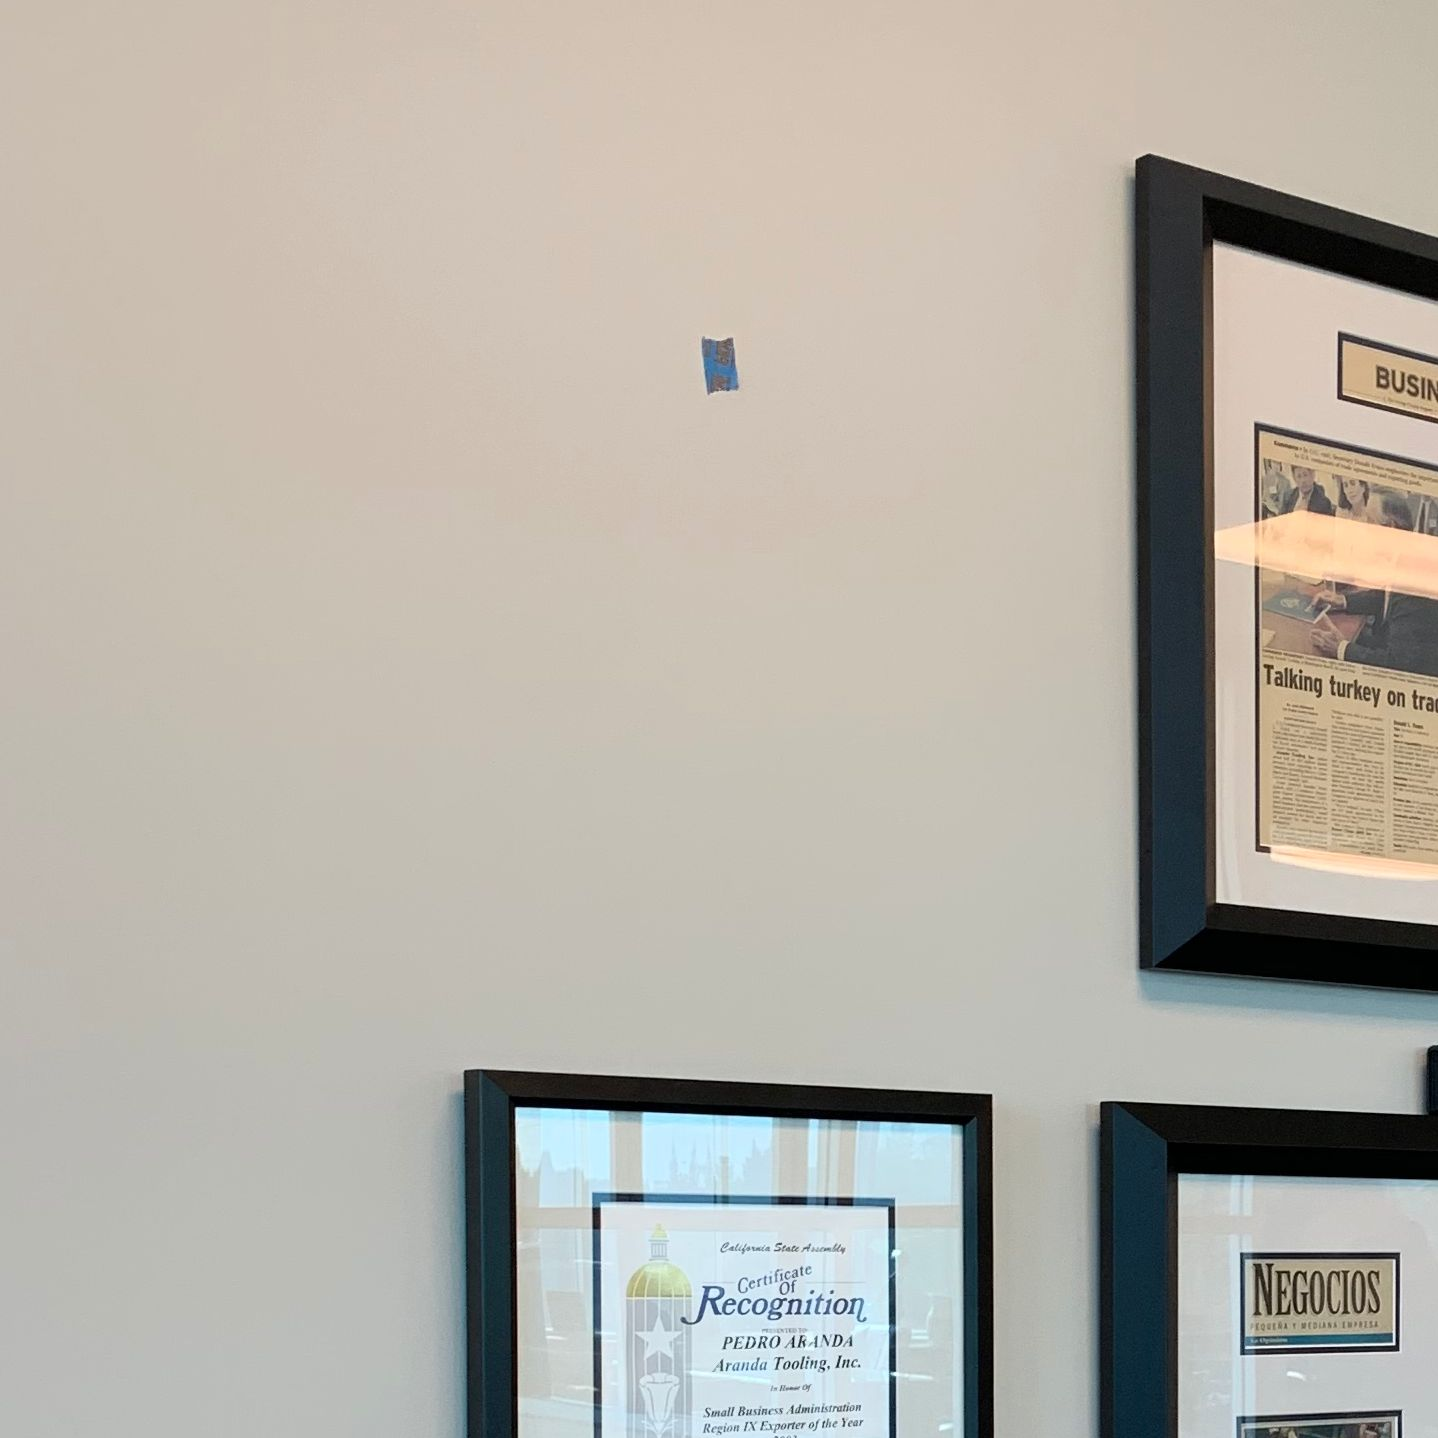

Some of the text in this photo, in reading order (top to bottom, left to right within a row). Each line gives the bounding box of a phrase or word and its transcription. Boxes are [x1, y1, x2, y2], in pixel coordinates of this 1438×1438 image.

[1263, 664, 1323, 698] Talking
[1329, 675, 1381, 707] turkey
[1387, 686, 1406, 707] on
[720, 1241, 846, 1255] California State Assembly
[737, 1264, 813, 1294] Certificate
[779, 1279, 796, 1296] Of
[1252, 1262, 1382, 1318] NEGOCIOS
[680, 1285, 867, 1326] Recognition
[1300, 1320, 1338, 1329] MEDIANA
[1342, 1320, 1379, 1329] EMPRESA
[721, 1333, 854, 1350] PEDRO ARANDA
[712, 1355, 861, 1374] Aranda Tooling, Inc.
[703, 1401, 862, 1419] Small Business Administration
[702, 1417, 864, 1436] Region IX Exporter of the Year
